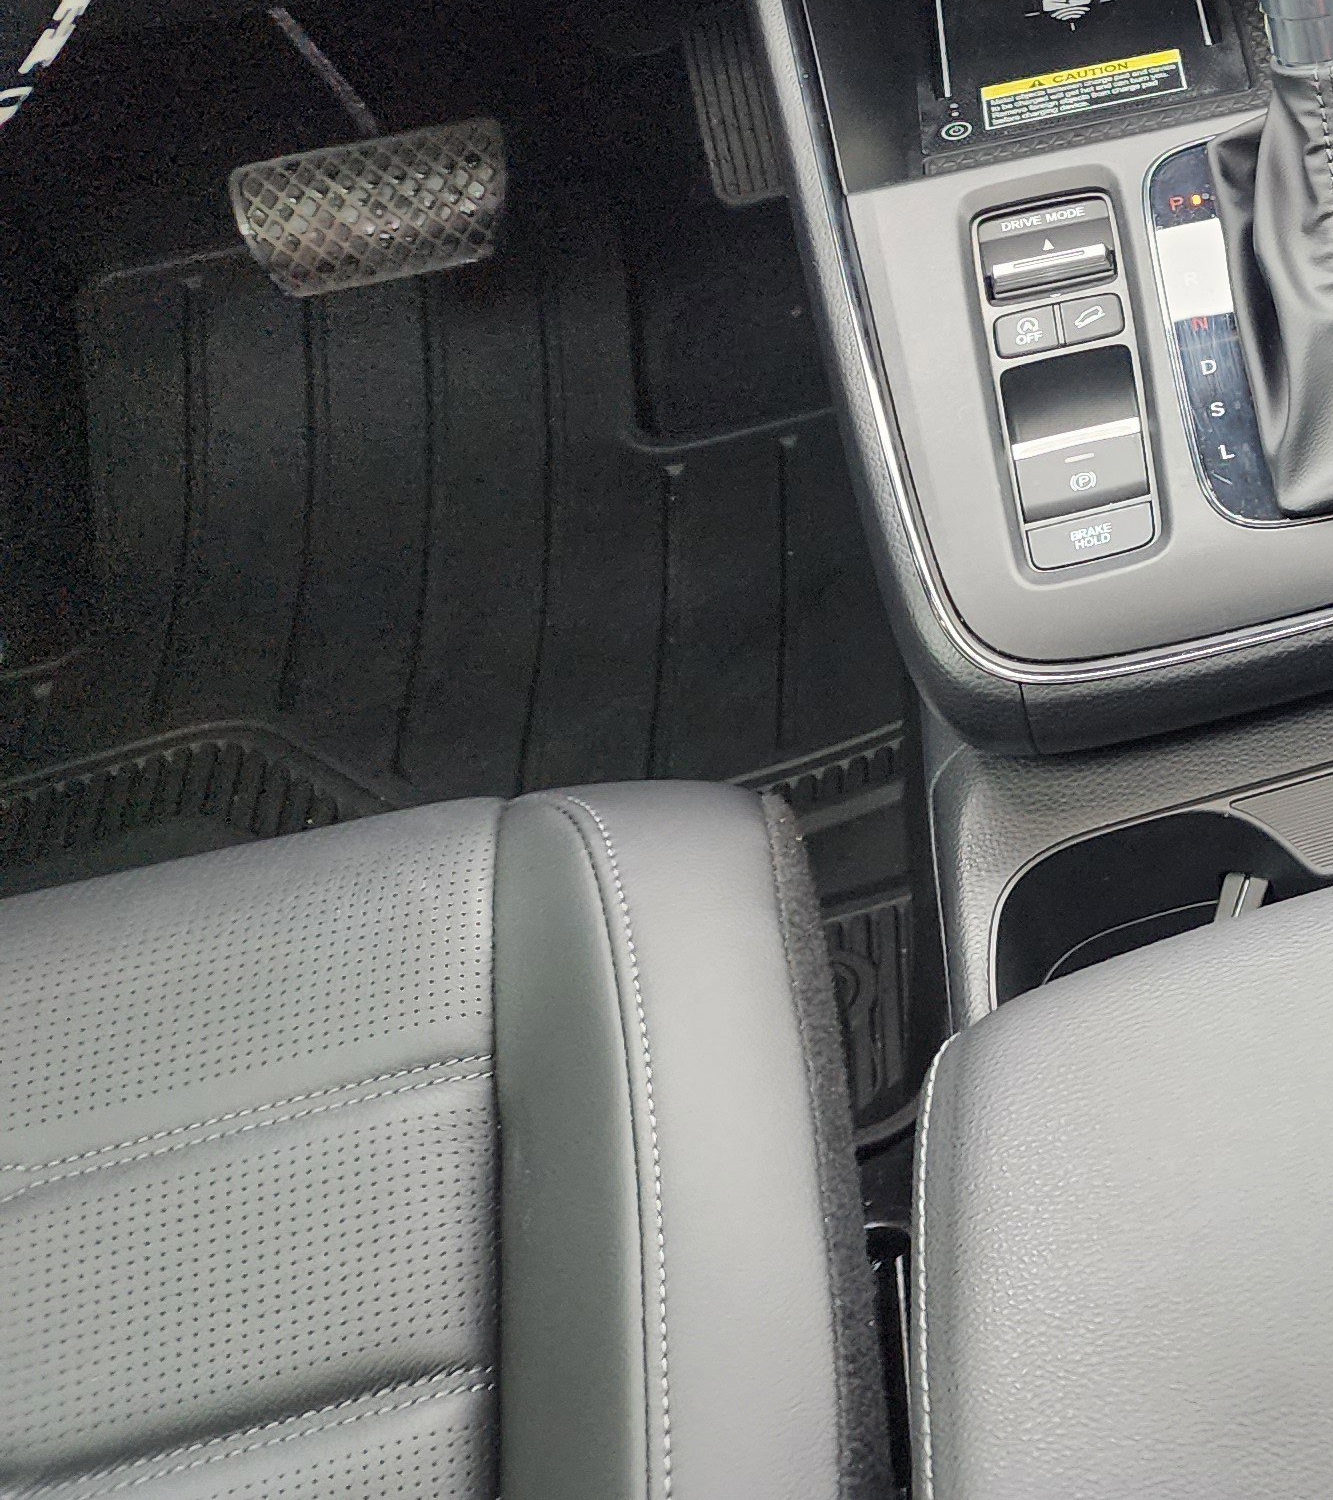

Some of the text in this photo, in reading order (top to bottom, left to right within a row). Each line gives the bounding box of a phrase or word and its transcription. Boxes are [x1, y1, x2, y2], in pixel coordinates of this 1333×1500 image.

[1052, 62, 1129, 83] CAUTION
[1170, 196, 1184, 211] P
[1001, 206, 1085, 232] DRIVE MODE
[1184, 271, 1199, 287] R
[1192, 316, 1208, 331] N
[1015, 331, 1043, 347] OFF
[1201, 359, 1217, 376] D
[1210, 401, 1225, 417] S
[1218, 445, 1236, 460] L
[1070, 522, 1112, 542] BRAKE
[1074, 533, 1111, 550] HOLD
